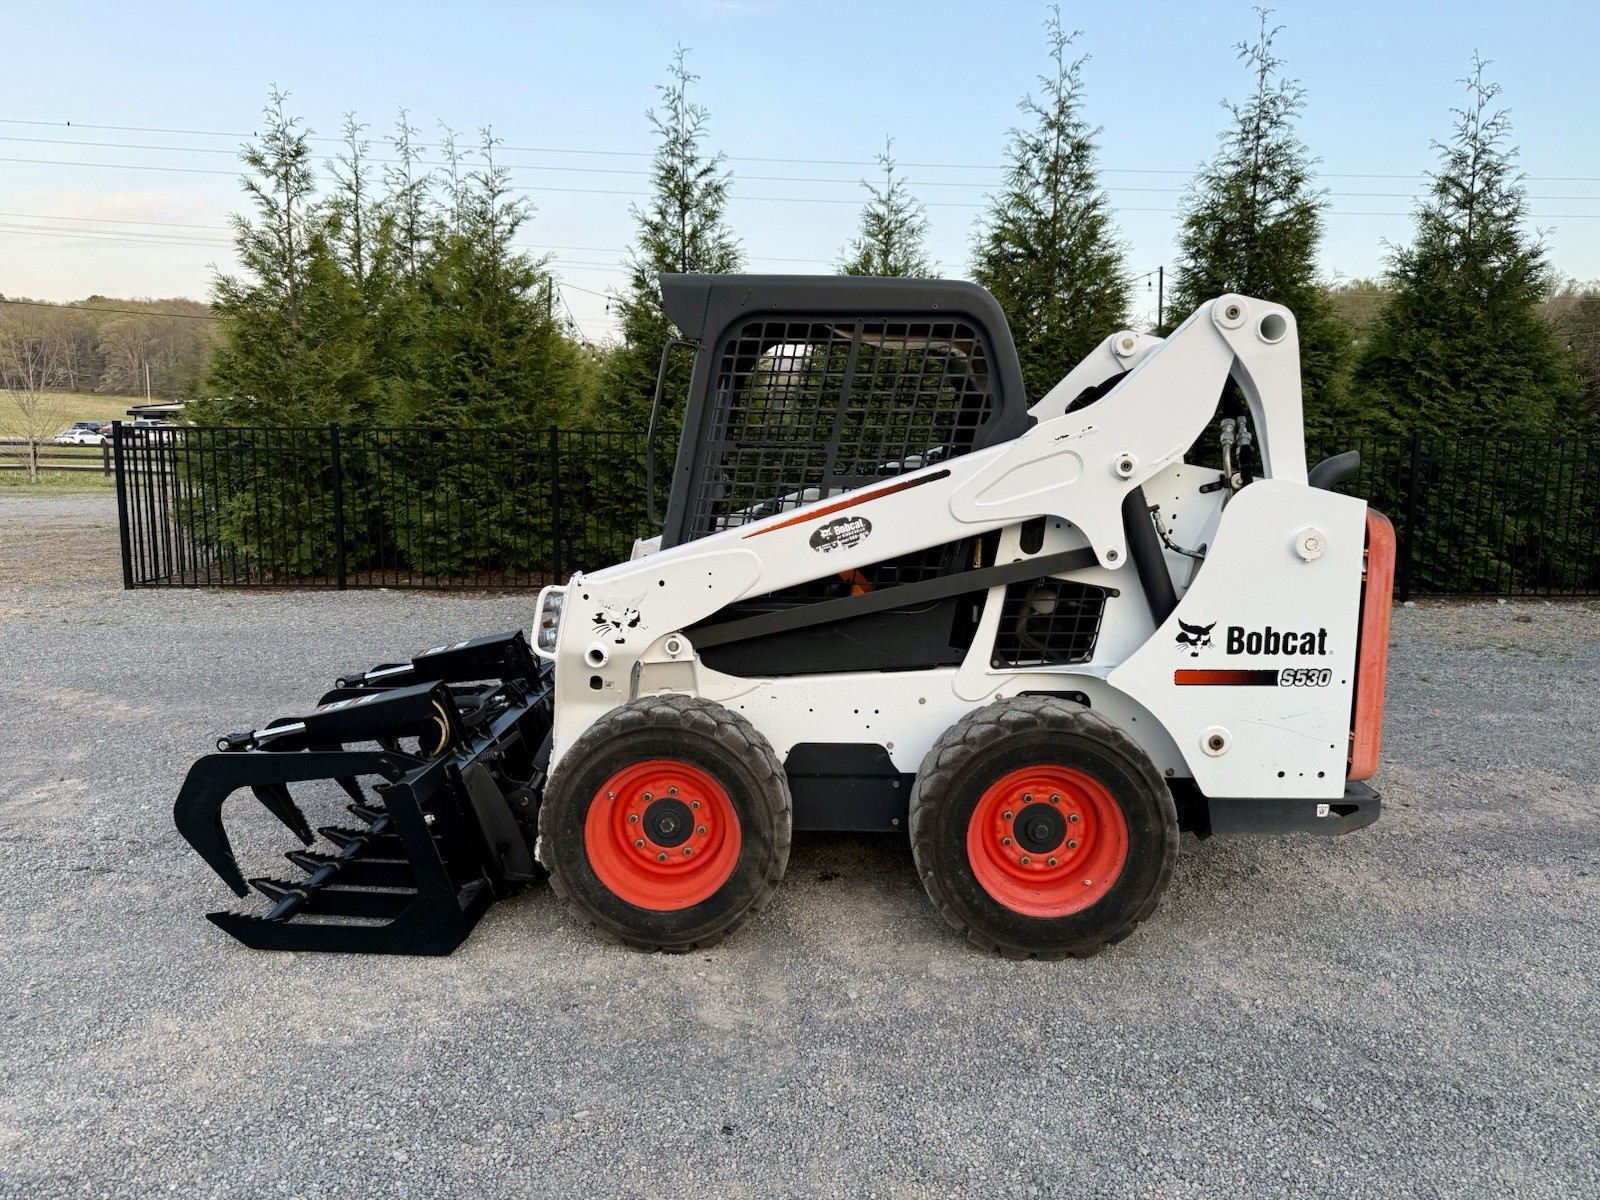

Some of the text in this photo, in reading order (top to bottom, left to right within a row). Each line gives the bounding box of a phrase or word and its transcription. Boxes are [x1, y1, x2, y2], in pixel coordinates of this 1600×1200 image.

[834, 519, 863, 535] Bobcat
[1226, 626, 1328, 655] Bobcat
[1280, 668, 1332, 687] S530
